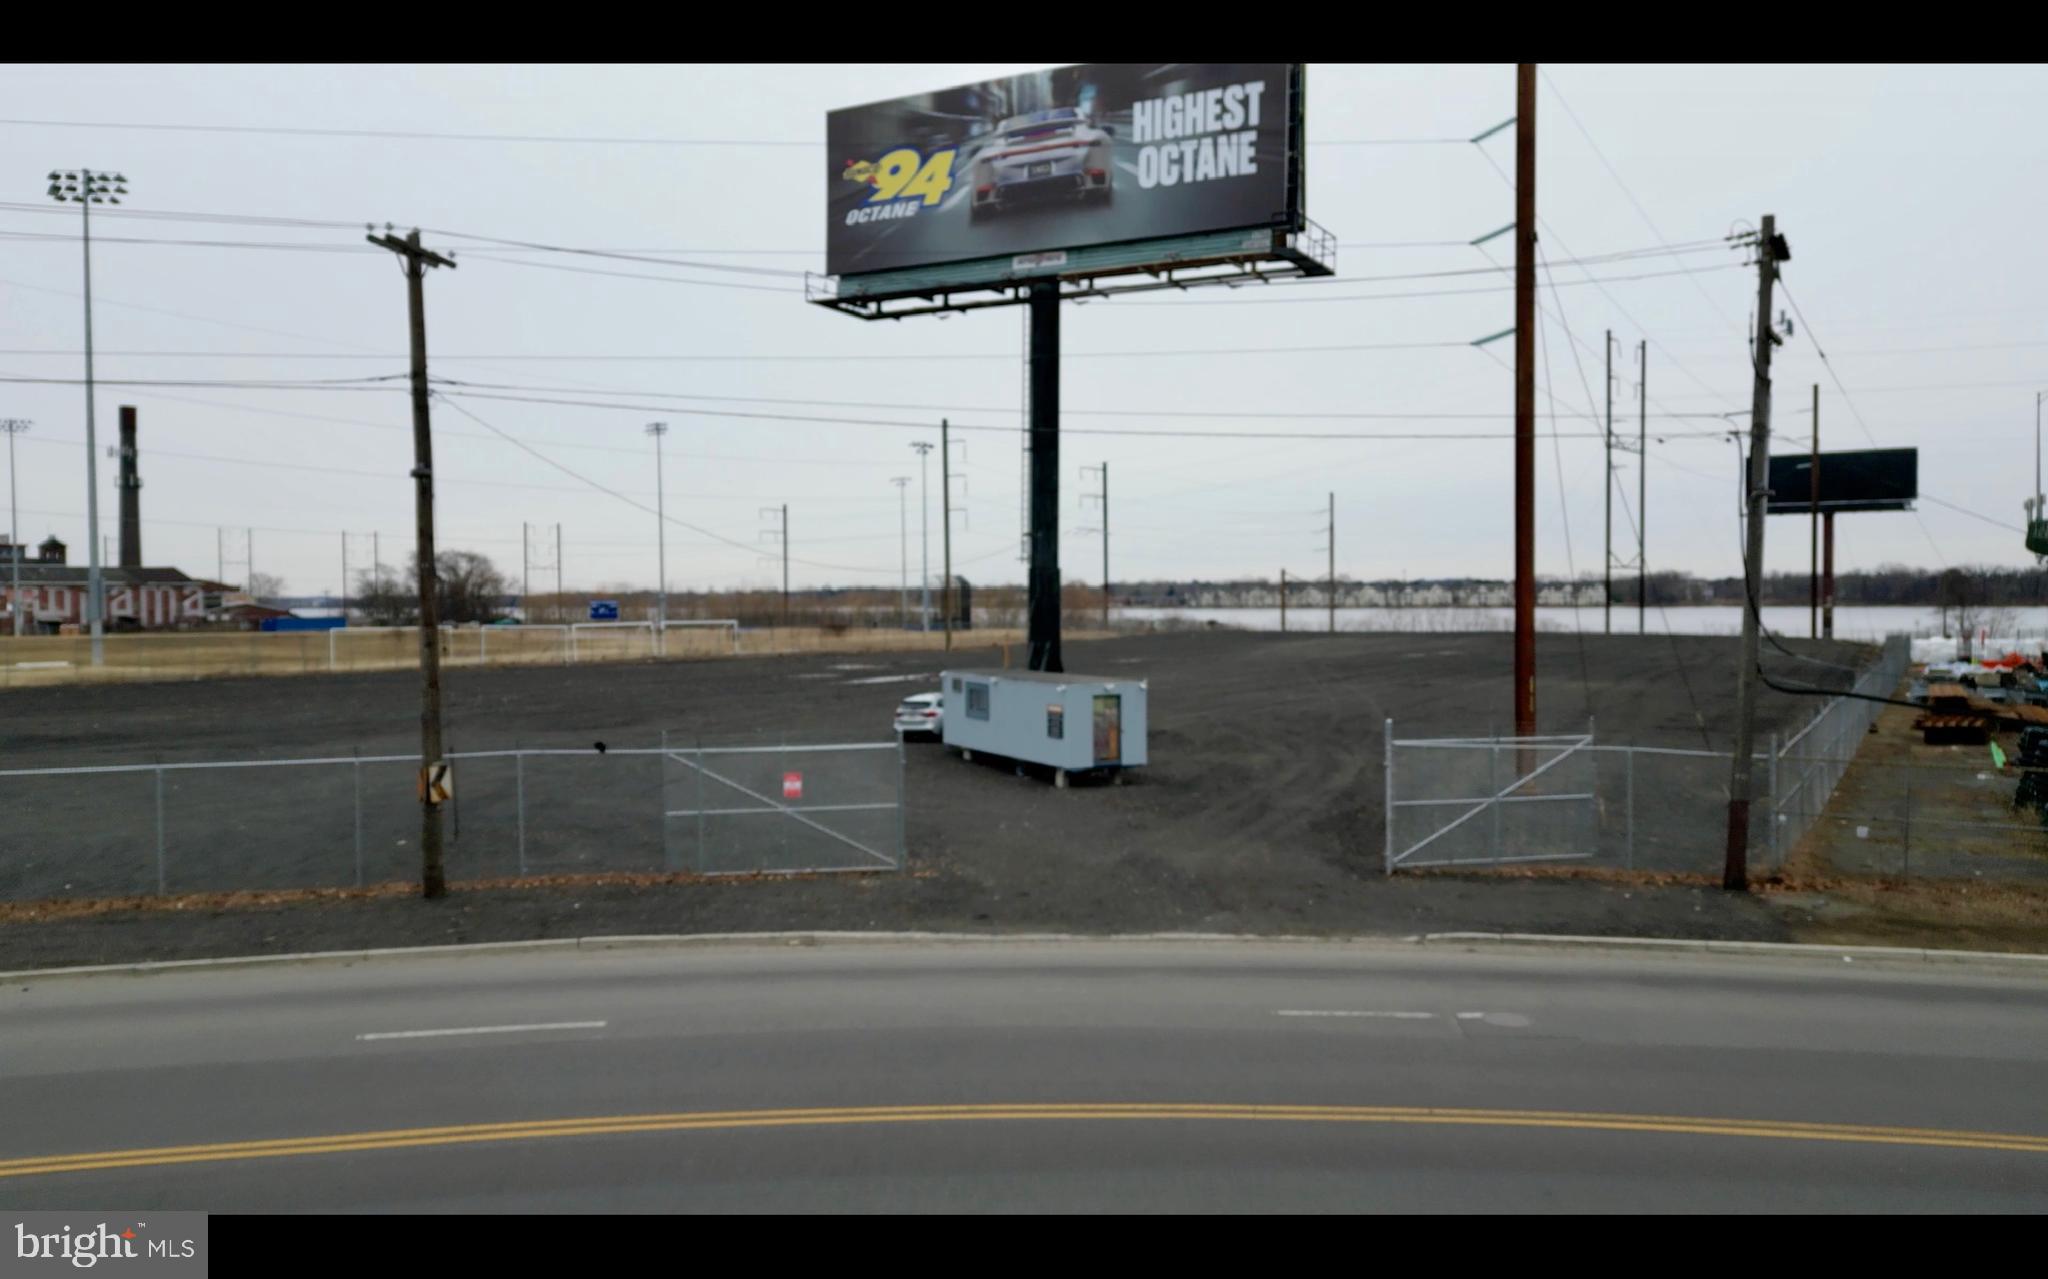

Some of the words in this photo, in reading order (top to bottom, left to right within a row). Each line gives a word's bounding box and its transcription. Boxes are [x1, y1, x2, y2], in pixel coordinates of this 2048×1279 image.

[1133, 81, 1265, 143] HIGHEST
[867, 148, 956, 206] 94
[1138, 131, 1257, 189] OCTANE
[845, 200, 920, 227] OCTANE
